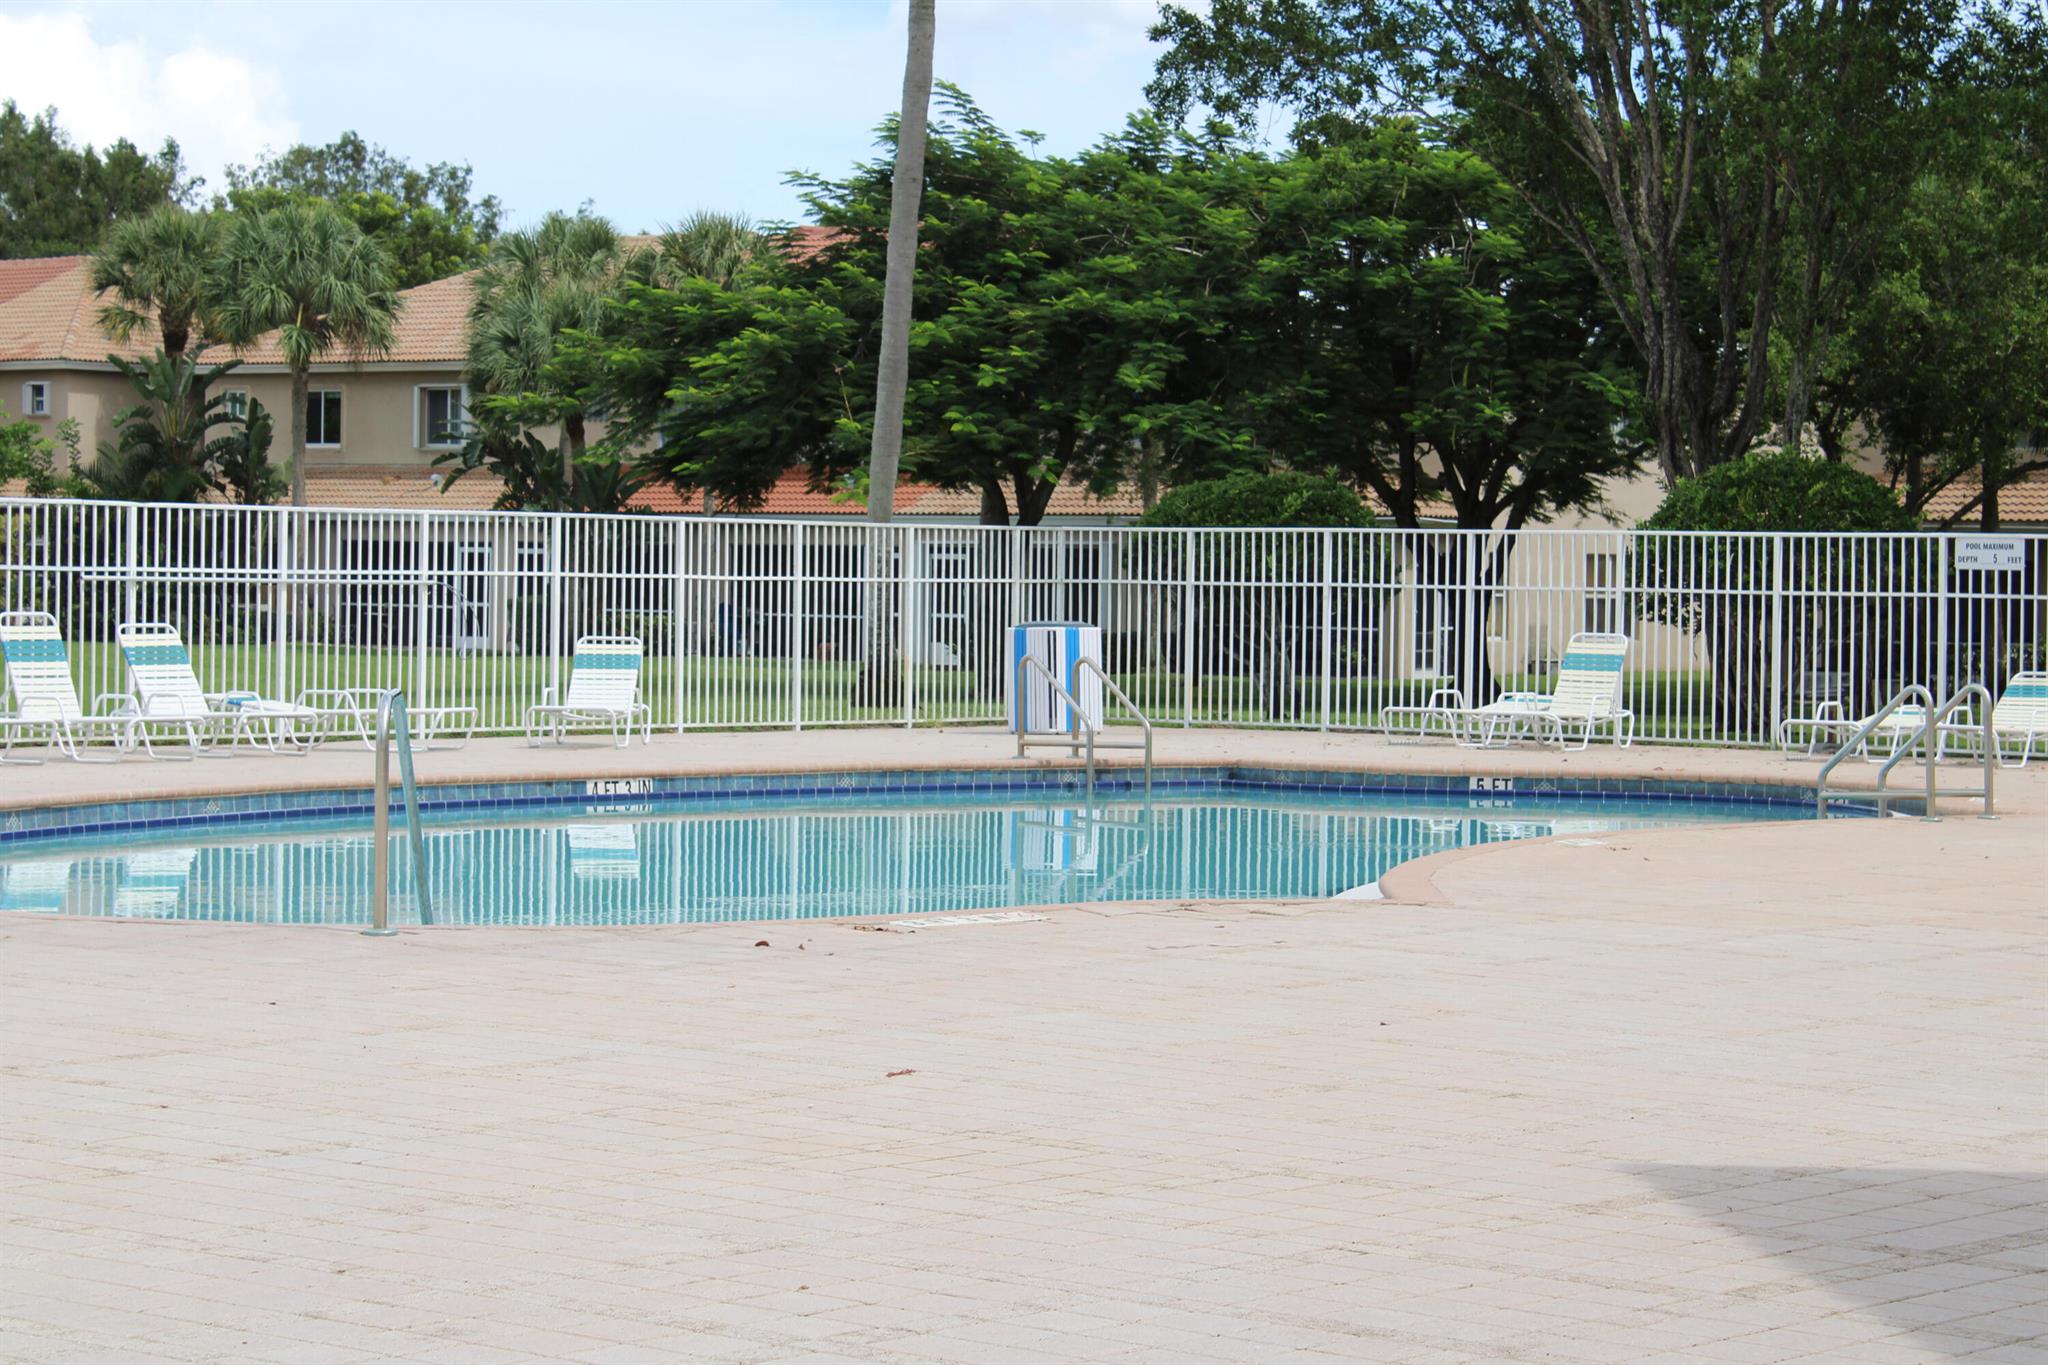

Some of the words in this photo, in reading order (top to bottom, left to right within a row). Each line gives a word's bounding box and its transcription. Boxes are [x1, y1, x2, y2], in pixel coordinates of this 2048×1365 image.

[1965, 542, 1981, 550] POOL
[1957, 555, 1978, 563] DEPTH
[1993, 553, 1998, 564] 5
[2007, 556, 2022, 564] FEET
[604, 780, 619, 795] FT
[638, 779, 651, 794] IN
[1492, 777, 1511, 790] FT
